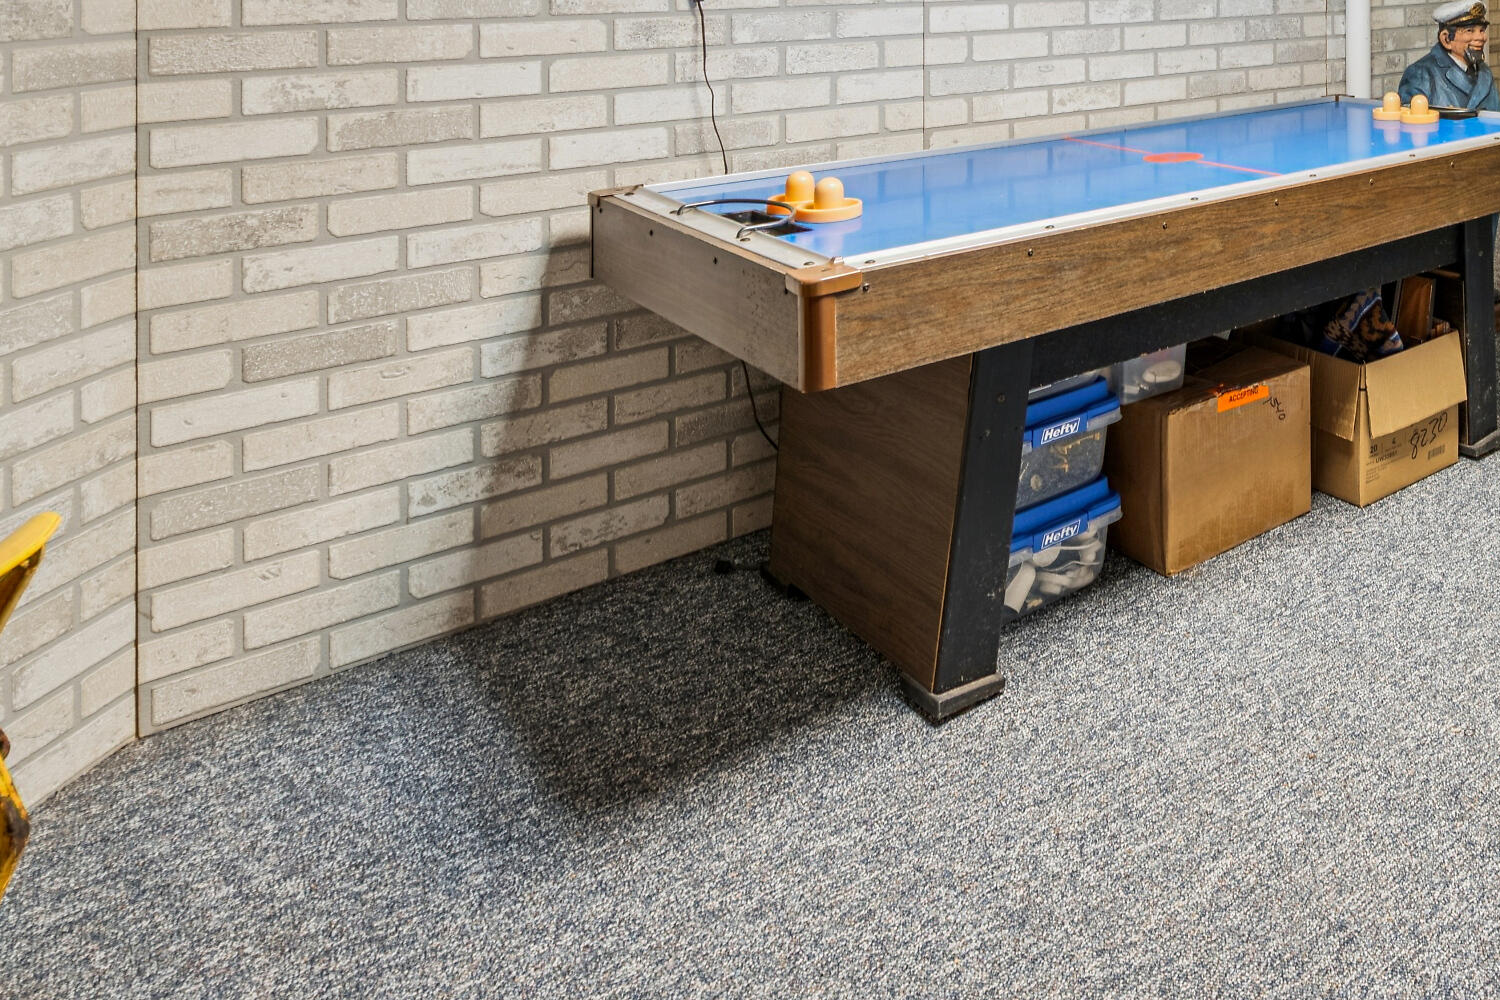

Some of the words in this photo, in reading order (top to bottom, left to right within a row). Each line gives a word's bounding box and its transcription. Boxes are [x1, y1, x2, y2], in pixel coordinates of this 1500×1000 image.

[1043, 422, 1078, 442] Hefty
[1409, 411, 1448, 460] 8230
[1043, 522, 1078, 546] Hefty
